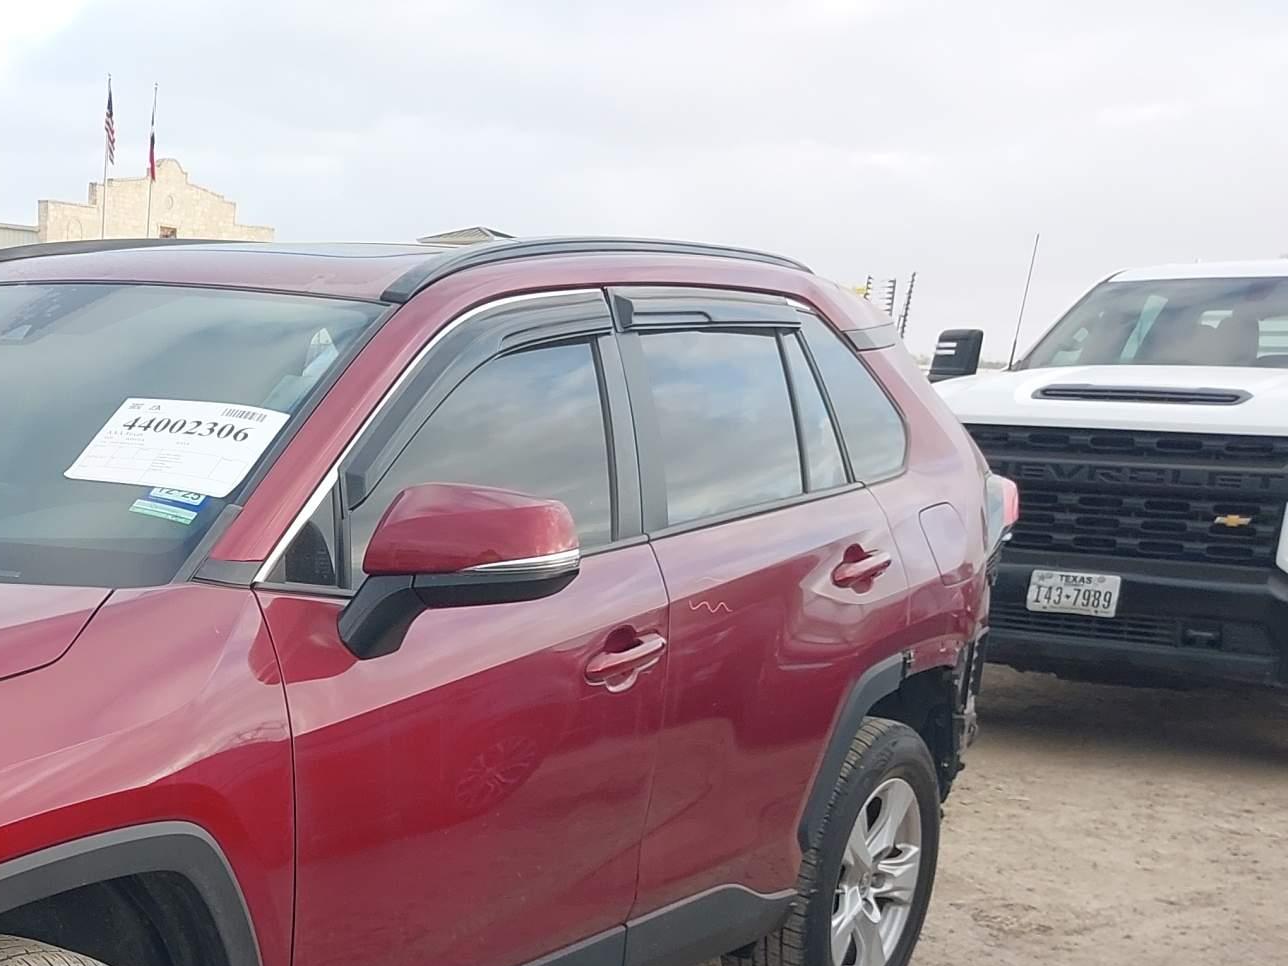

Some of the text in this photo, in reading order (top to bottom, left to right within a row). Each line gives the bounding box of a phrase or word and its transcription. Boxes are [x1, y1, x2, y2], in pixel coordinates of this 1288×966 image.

[123, 416, 256, 442] 44002306
[1059, 575, 1094, 585] TEXAS
[1072, 588, 1113, 609] 7989
